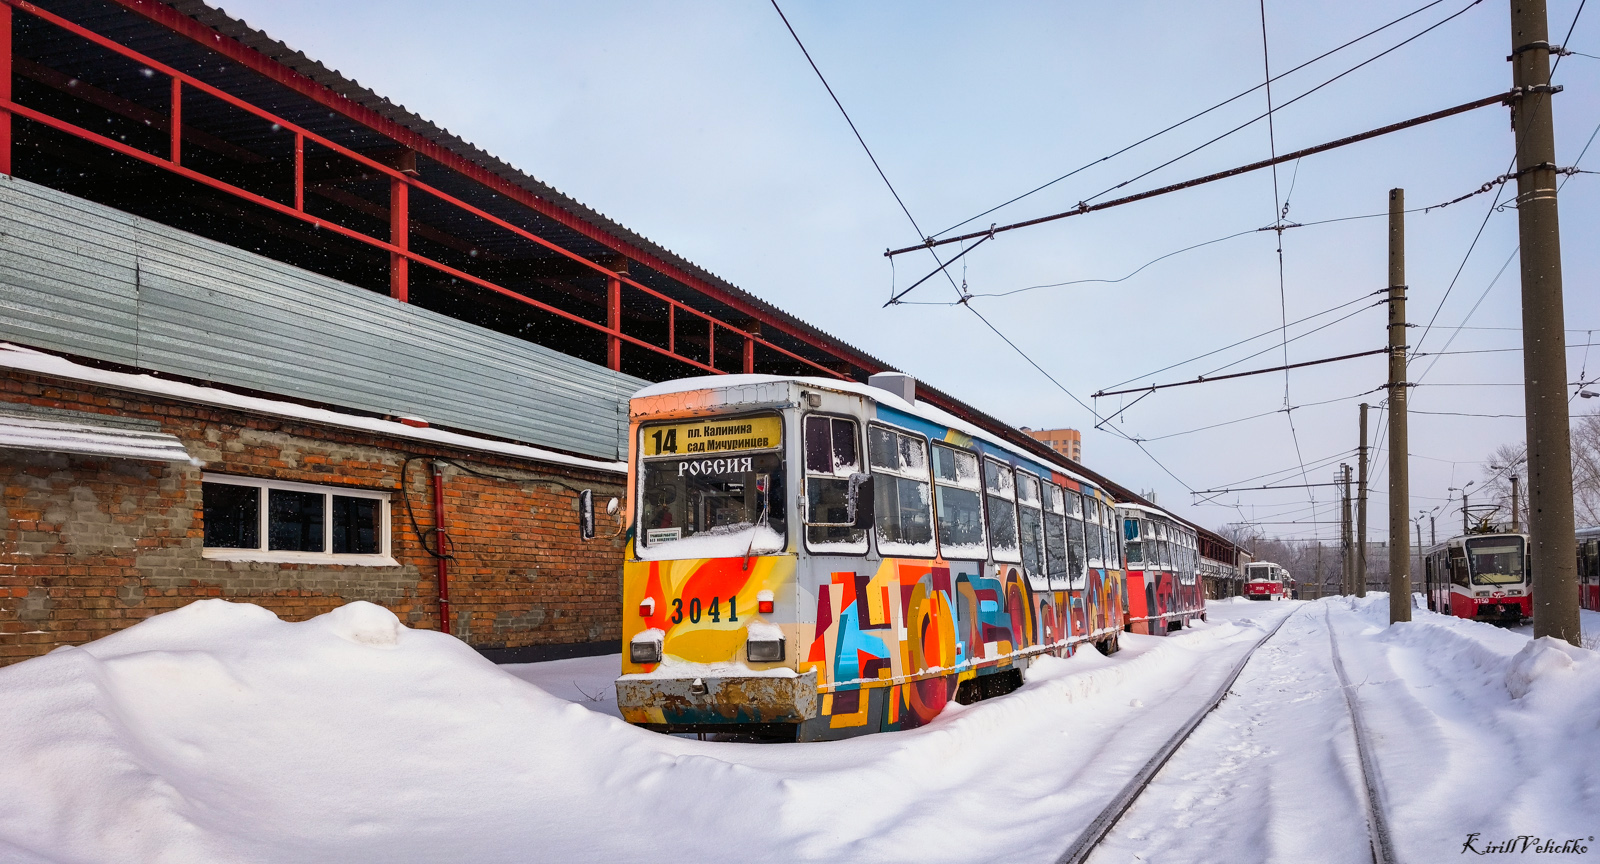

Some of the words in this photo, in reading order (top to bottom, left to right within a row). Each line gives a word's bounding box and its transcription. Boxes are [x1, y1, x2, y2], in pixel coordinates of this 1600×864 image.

[687, 428, 702, 439] пл.
[703, 423, 753, 437] Калинина
[651, 428, 678, 455] 14
[687, 441, 705, 453] сад
[706, 436, 769, 451] Мичуринцев
[677, 457, 753, 477] РОССИЯ
[671, 595, 738, 624] 3041
